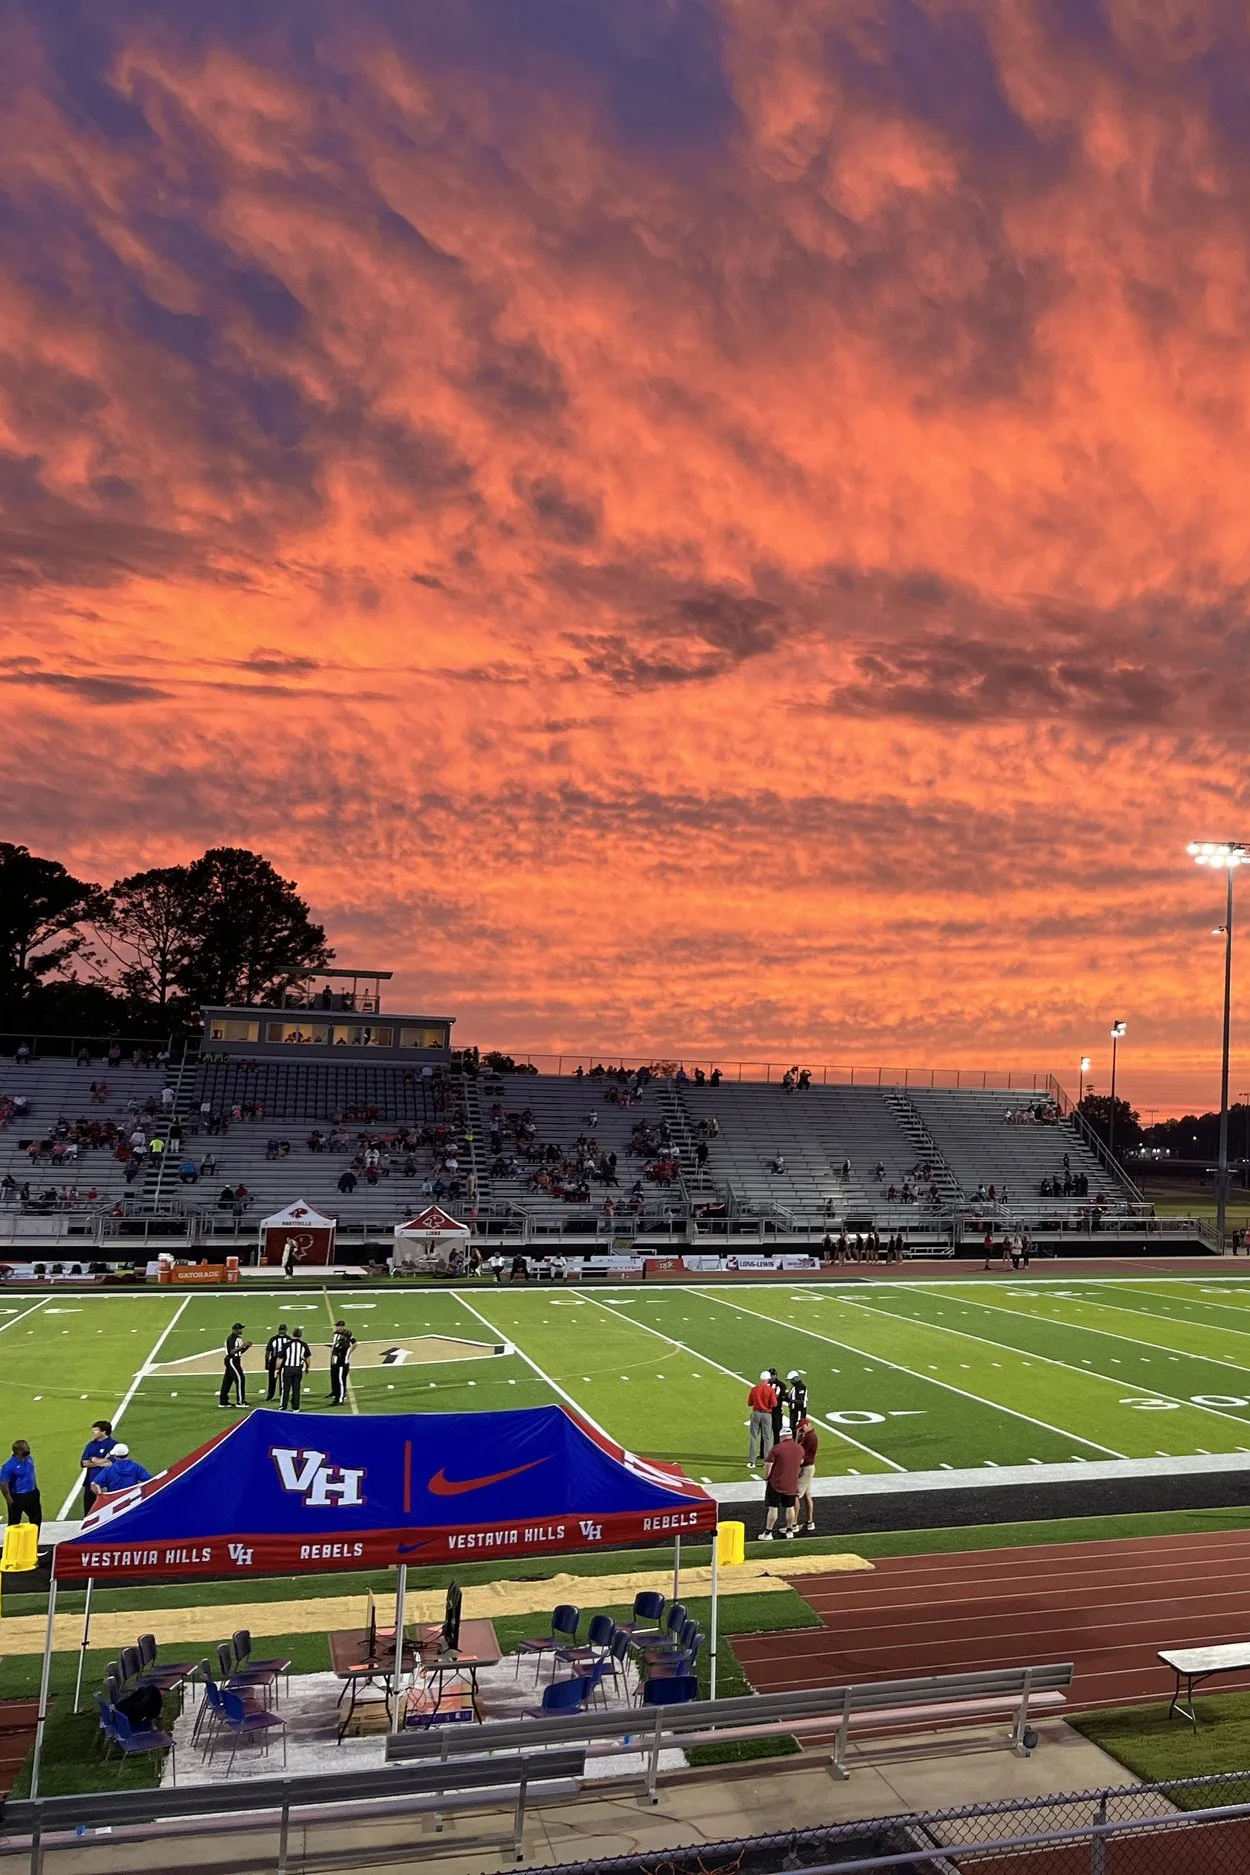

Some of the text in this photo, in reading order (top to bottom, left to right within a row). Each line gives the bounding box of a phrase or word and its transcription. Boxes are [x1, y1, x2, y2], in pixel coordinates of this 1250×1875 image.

[739, 1260, 775, 1268] LONG-LEWIS
[178, 1271, 220, 1279] GATORADE
[1118, 1394, 1250, 1410] 30
[270, 1447, 365, 1507] VH
[579, 1520, 603, 1540] VH
[643, 1512, 698, 1531] REBELS
[448, 1525, 565, 1549] VESTAVIA HILLS
[81, 1547, 212, 1567] VESTAVIA HILLS
[227, 1543, 254, 1565] VH
[300, 1542, 363, 1560] REBELS
